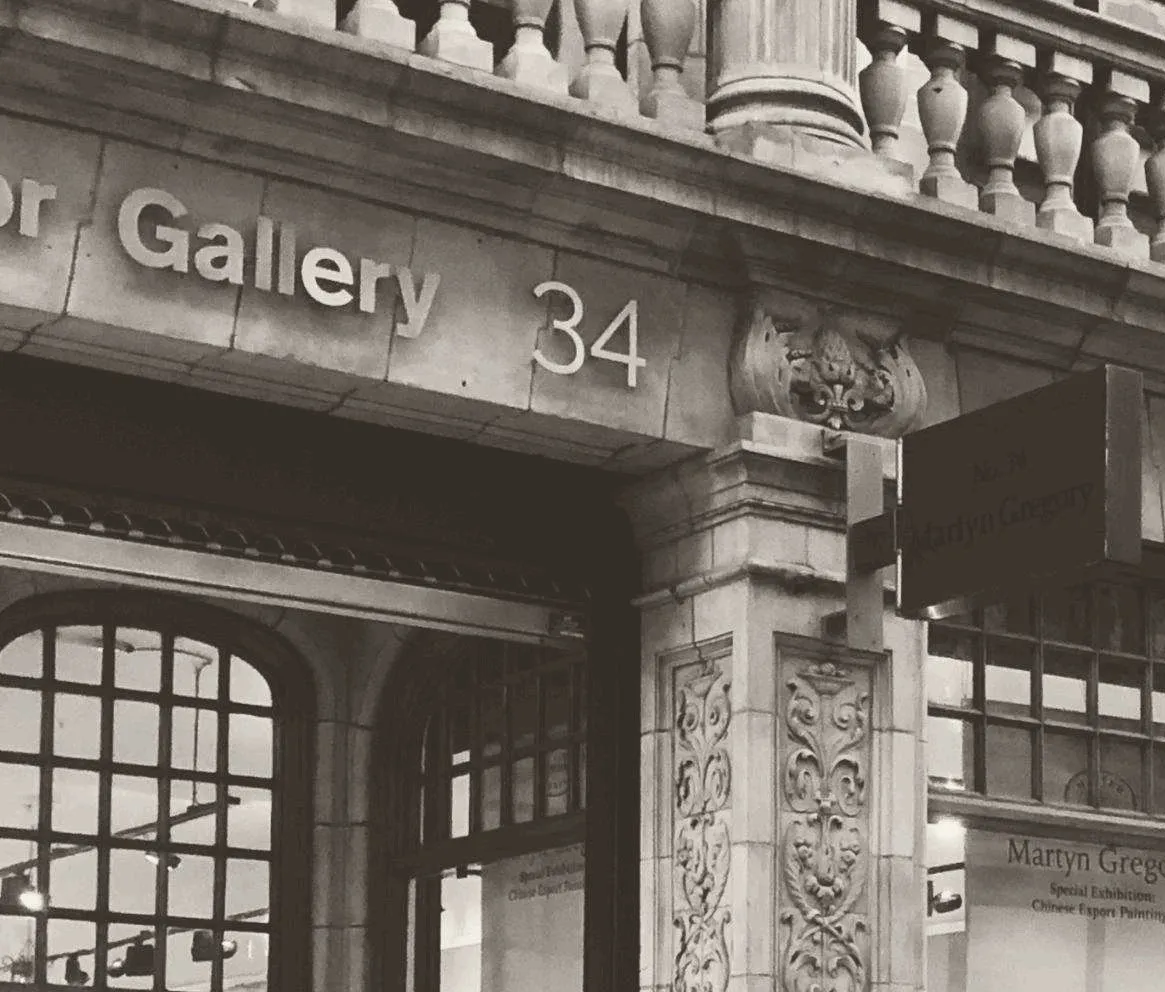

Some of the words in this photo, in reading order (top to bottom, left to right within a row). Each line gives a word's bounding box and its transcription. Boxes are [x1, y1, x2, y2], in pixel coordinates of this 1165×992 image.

[118, 187, 441, 339] Gallery
[532, 280, 647, 388] 34
[1007, 838, 1090, 878] Martyn
[1050, 882, 1088, 899] Special
[1032, 898, 1076, 915] Chinese
[1079, 902, 1116, 920] Export
